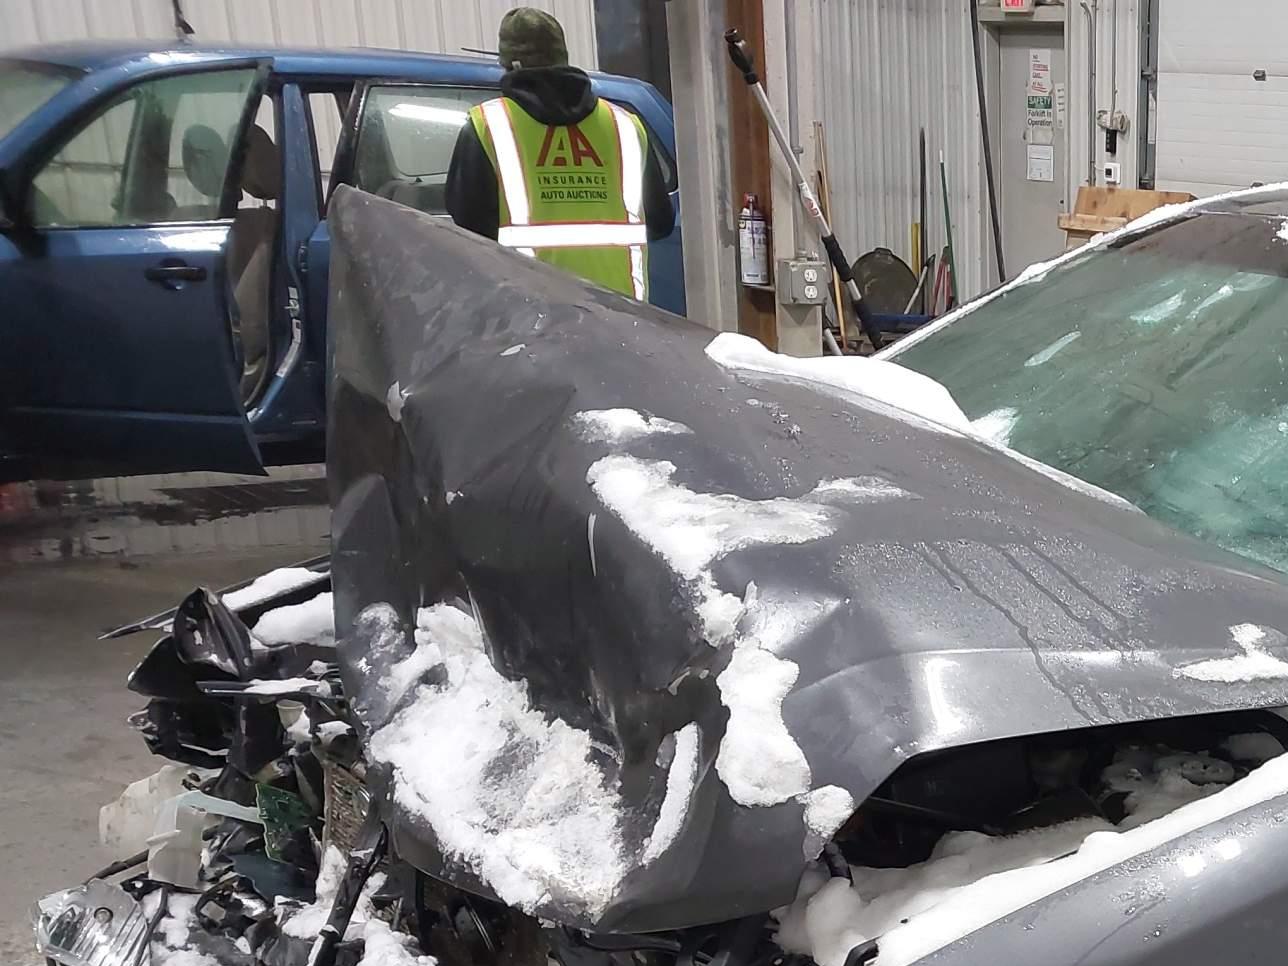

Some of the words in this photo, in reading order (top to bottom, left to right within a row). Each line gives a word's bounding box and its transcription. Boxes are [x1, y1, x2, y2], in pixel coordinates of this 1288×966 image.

[538, 175, 607, 185] INSURANCE
[541, 190, 565, 199] AUTO
[567, 190, 608, 200] AUCTIONS
